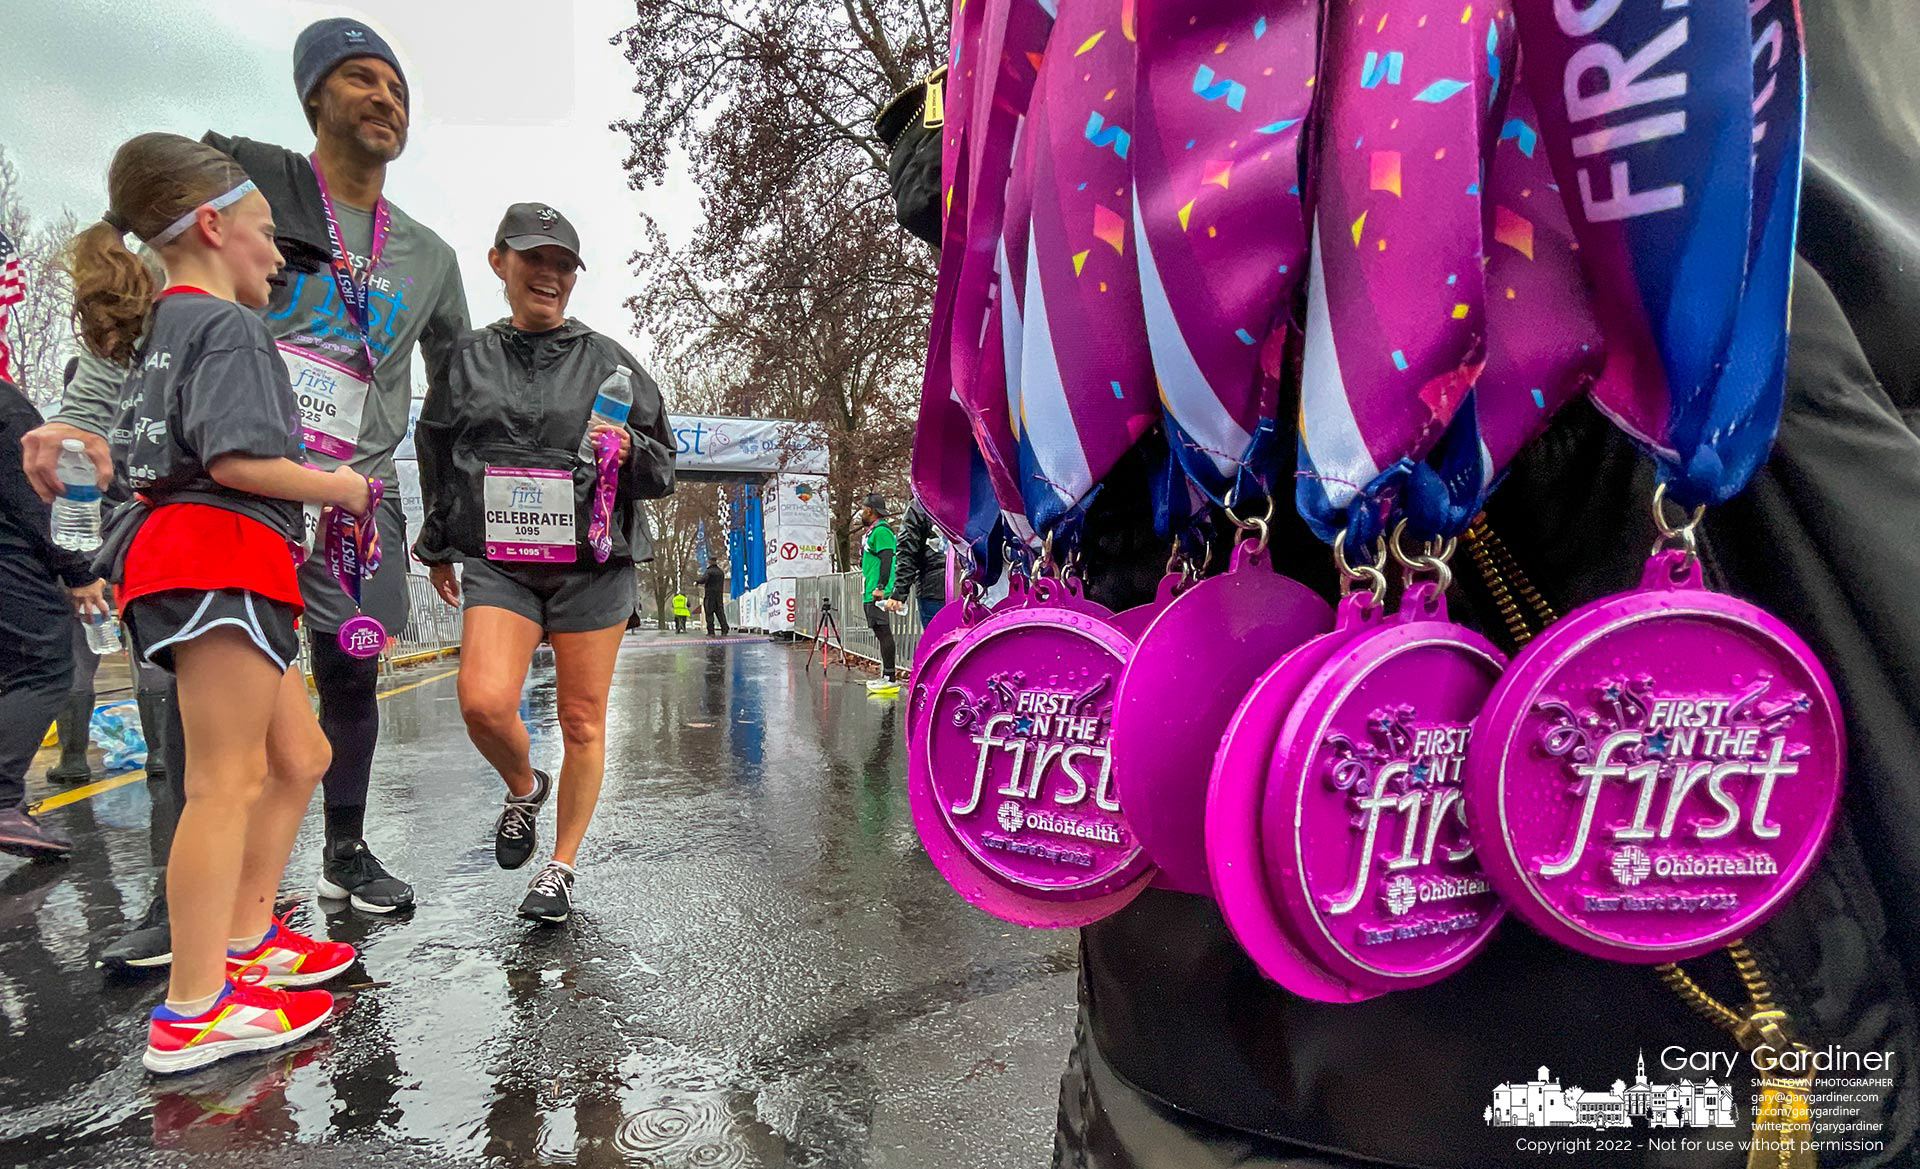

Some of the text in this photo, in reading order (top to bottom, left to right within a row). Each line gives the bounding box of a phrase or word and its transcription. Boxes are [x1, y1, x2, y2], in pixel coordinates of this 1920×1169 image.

[299, 394, 337, 418] OUG
[486, 510, 574, 527] CELEBRATE!
[514, 526, 541, 536] 1095
[344, 539, 356, 576] FIRST
[518, 547, 540, 556] 1095
[1016, 691, 1074, 715] FIRST
[1649, 700, 1730, 728] FIRST
[1054, 716, 1098, 741] THE
[1412, 728, 1471, 757] FIRST
[1703, 728, 1761, 756] THE
[1026, 814, 1120, 843] OhioHealth
[1655, 853, 1779, 878] OhioHealth
